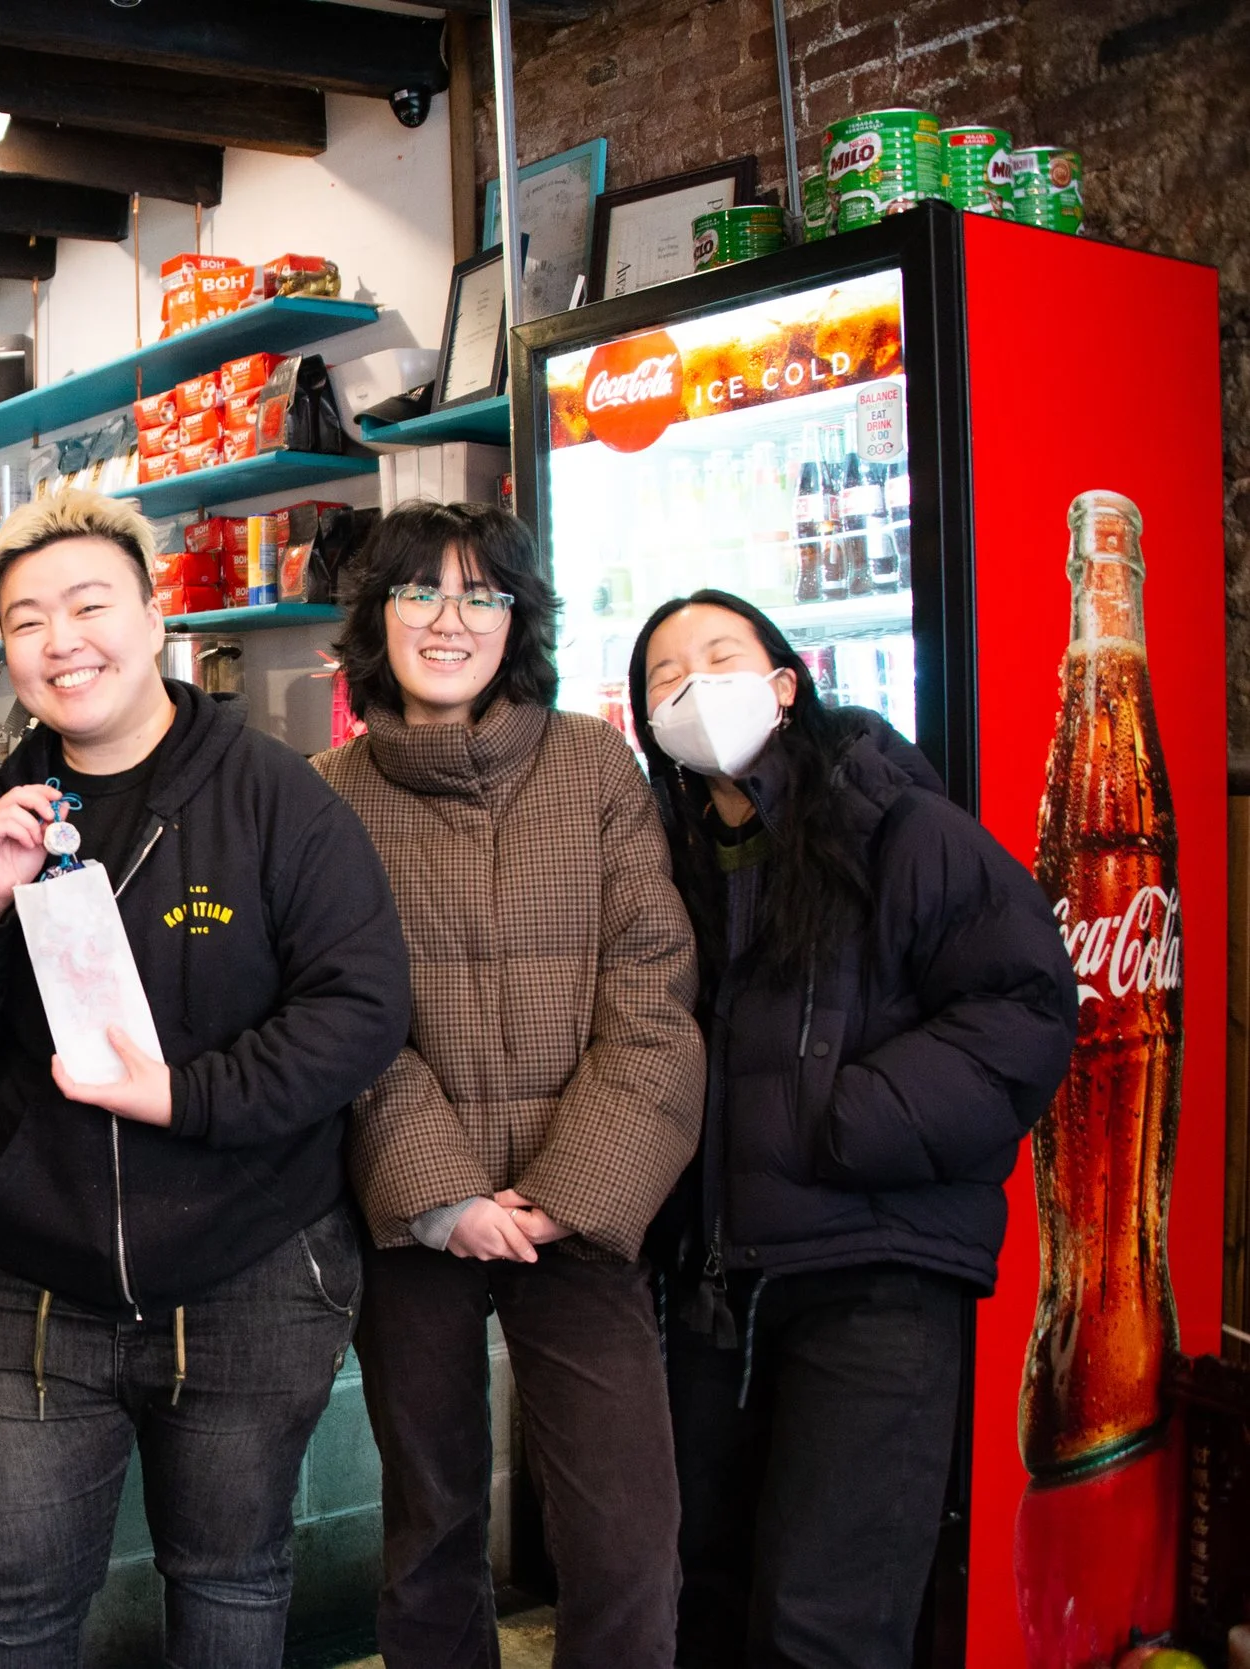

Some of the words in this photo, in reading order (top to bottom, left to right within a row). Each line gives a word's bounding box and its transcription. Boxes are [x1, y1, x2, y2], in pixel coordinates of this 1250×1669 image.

[830, 144, 875, 176] MILO
[586, 353, 678, 412] Coca-Cola
[694, 376, 744, 405] ICE
[762, 351, 851, 391] COLD
[860, 389, 899, 404] BALANCE
[871, 409, 886, 420] EAT
[867, 419, 892, 431] DRINK
[878, 430, 889, 440] DO
[277, 511, 289, 522] BO
